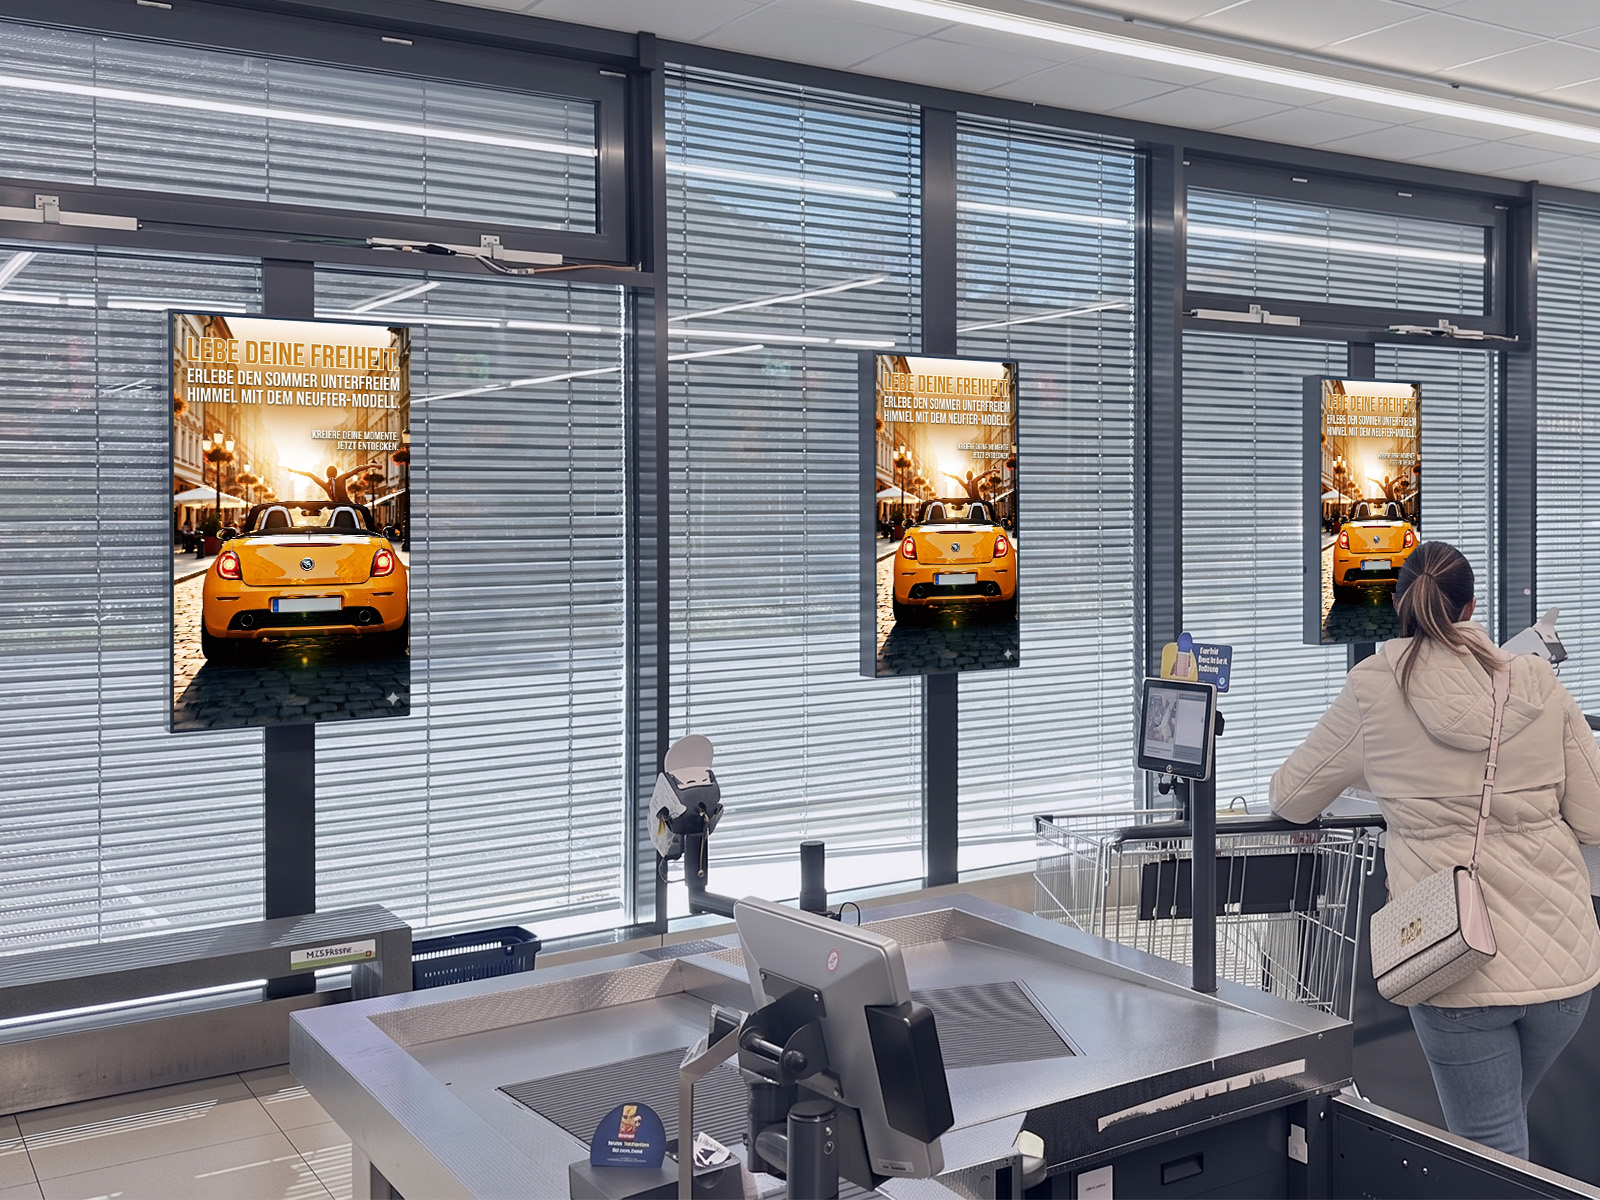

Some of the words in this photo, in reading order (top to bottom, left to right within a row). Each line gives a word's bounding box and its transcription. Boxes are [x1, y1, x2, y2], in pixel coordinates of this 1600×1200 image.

[187, 336, 240, 364] LEBE
[245, 339, 306, 368] DEINE
[310, 342, 400, 372] FREIHEIT.
[187, 368, 235, 385] ERLEBE
[237, 370, 262, 387] DEN
[265, 371, 318, 389] SOMMER
[321, 373, 400, 391] UNTERFREIEM
[883, 372, 915, 393] LEBE
[918, 374, 953, 394] DEINE
[956, 376, 1010, 397] FREIHEIT.
[187, 386, 238, 404] HIMMEL
[241, 388, 264, 405] MIT
[268, 389, 294, 406] DEM
[884, 396, 912, 408] ERLEBE
[914, 397, 928, 409] DEN
[930, 398, 960, 410] SOMMER
[1326, 393, 1349, 411] LEBE
[1350, 395, 1376, 412] DEINE
[1378, 396, 1416, 413] FREIHEIT.
[884, 410, 914, 422] HIMMEL
[916, 412, 929, 423] MIT
[930, 412, 946, 424] DEM
[312, 430, 341, 439] KREIERE
[342, 430, 362, 440] DEINE
[364, 432, 398, 440] MOMENTE.
[337, 441, 356, 450] JETZT
[358, 442, 398, 450] ENTDECKEN.
